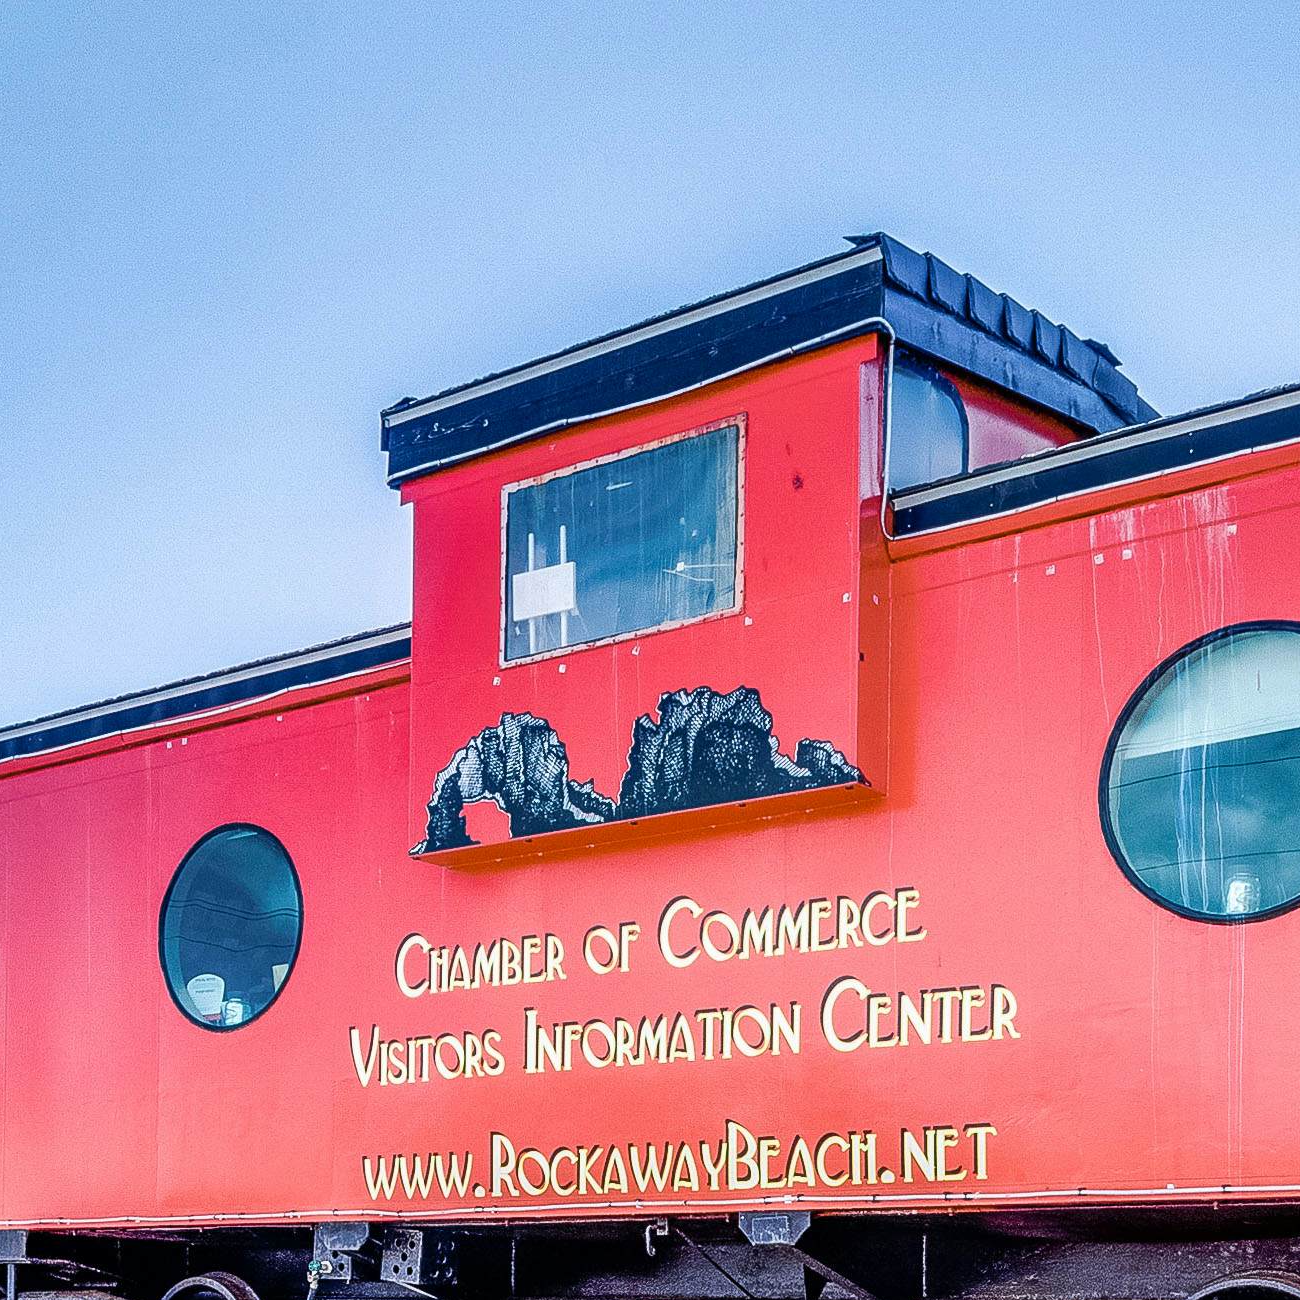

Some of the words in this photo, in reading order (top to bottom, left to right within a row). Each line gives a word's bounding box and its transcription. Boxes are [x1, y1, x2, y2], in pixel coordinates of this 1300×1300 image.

[395, 932, 567, 999] CHAMBER
[584, 921, 641, 975] OF
[658, 886, 928, 968] COMMERCE
[349, 1023, 506, 1087] VISITORS
[524, 1001, 802, 1075] INFORMATION
[820, 975, 1022, 1052] CENTER
